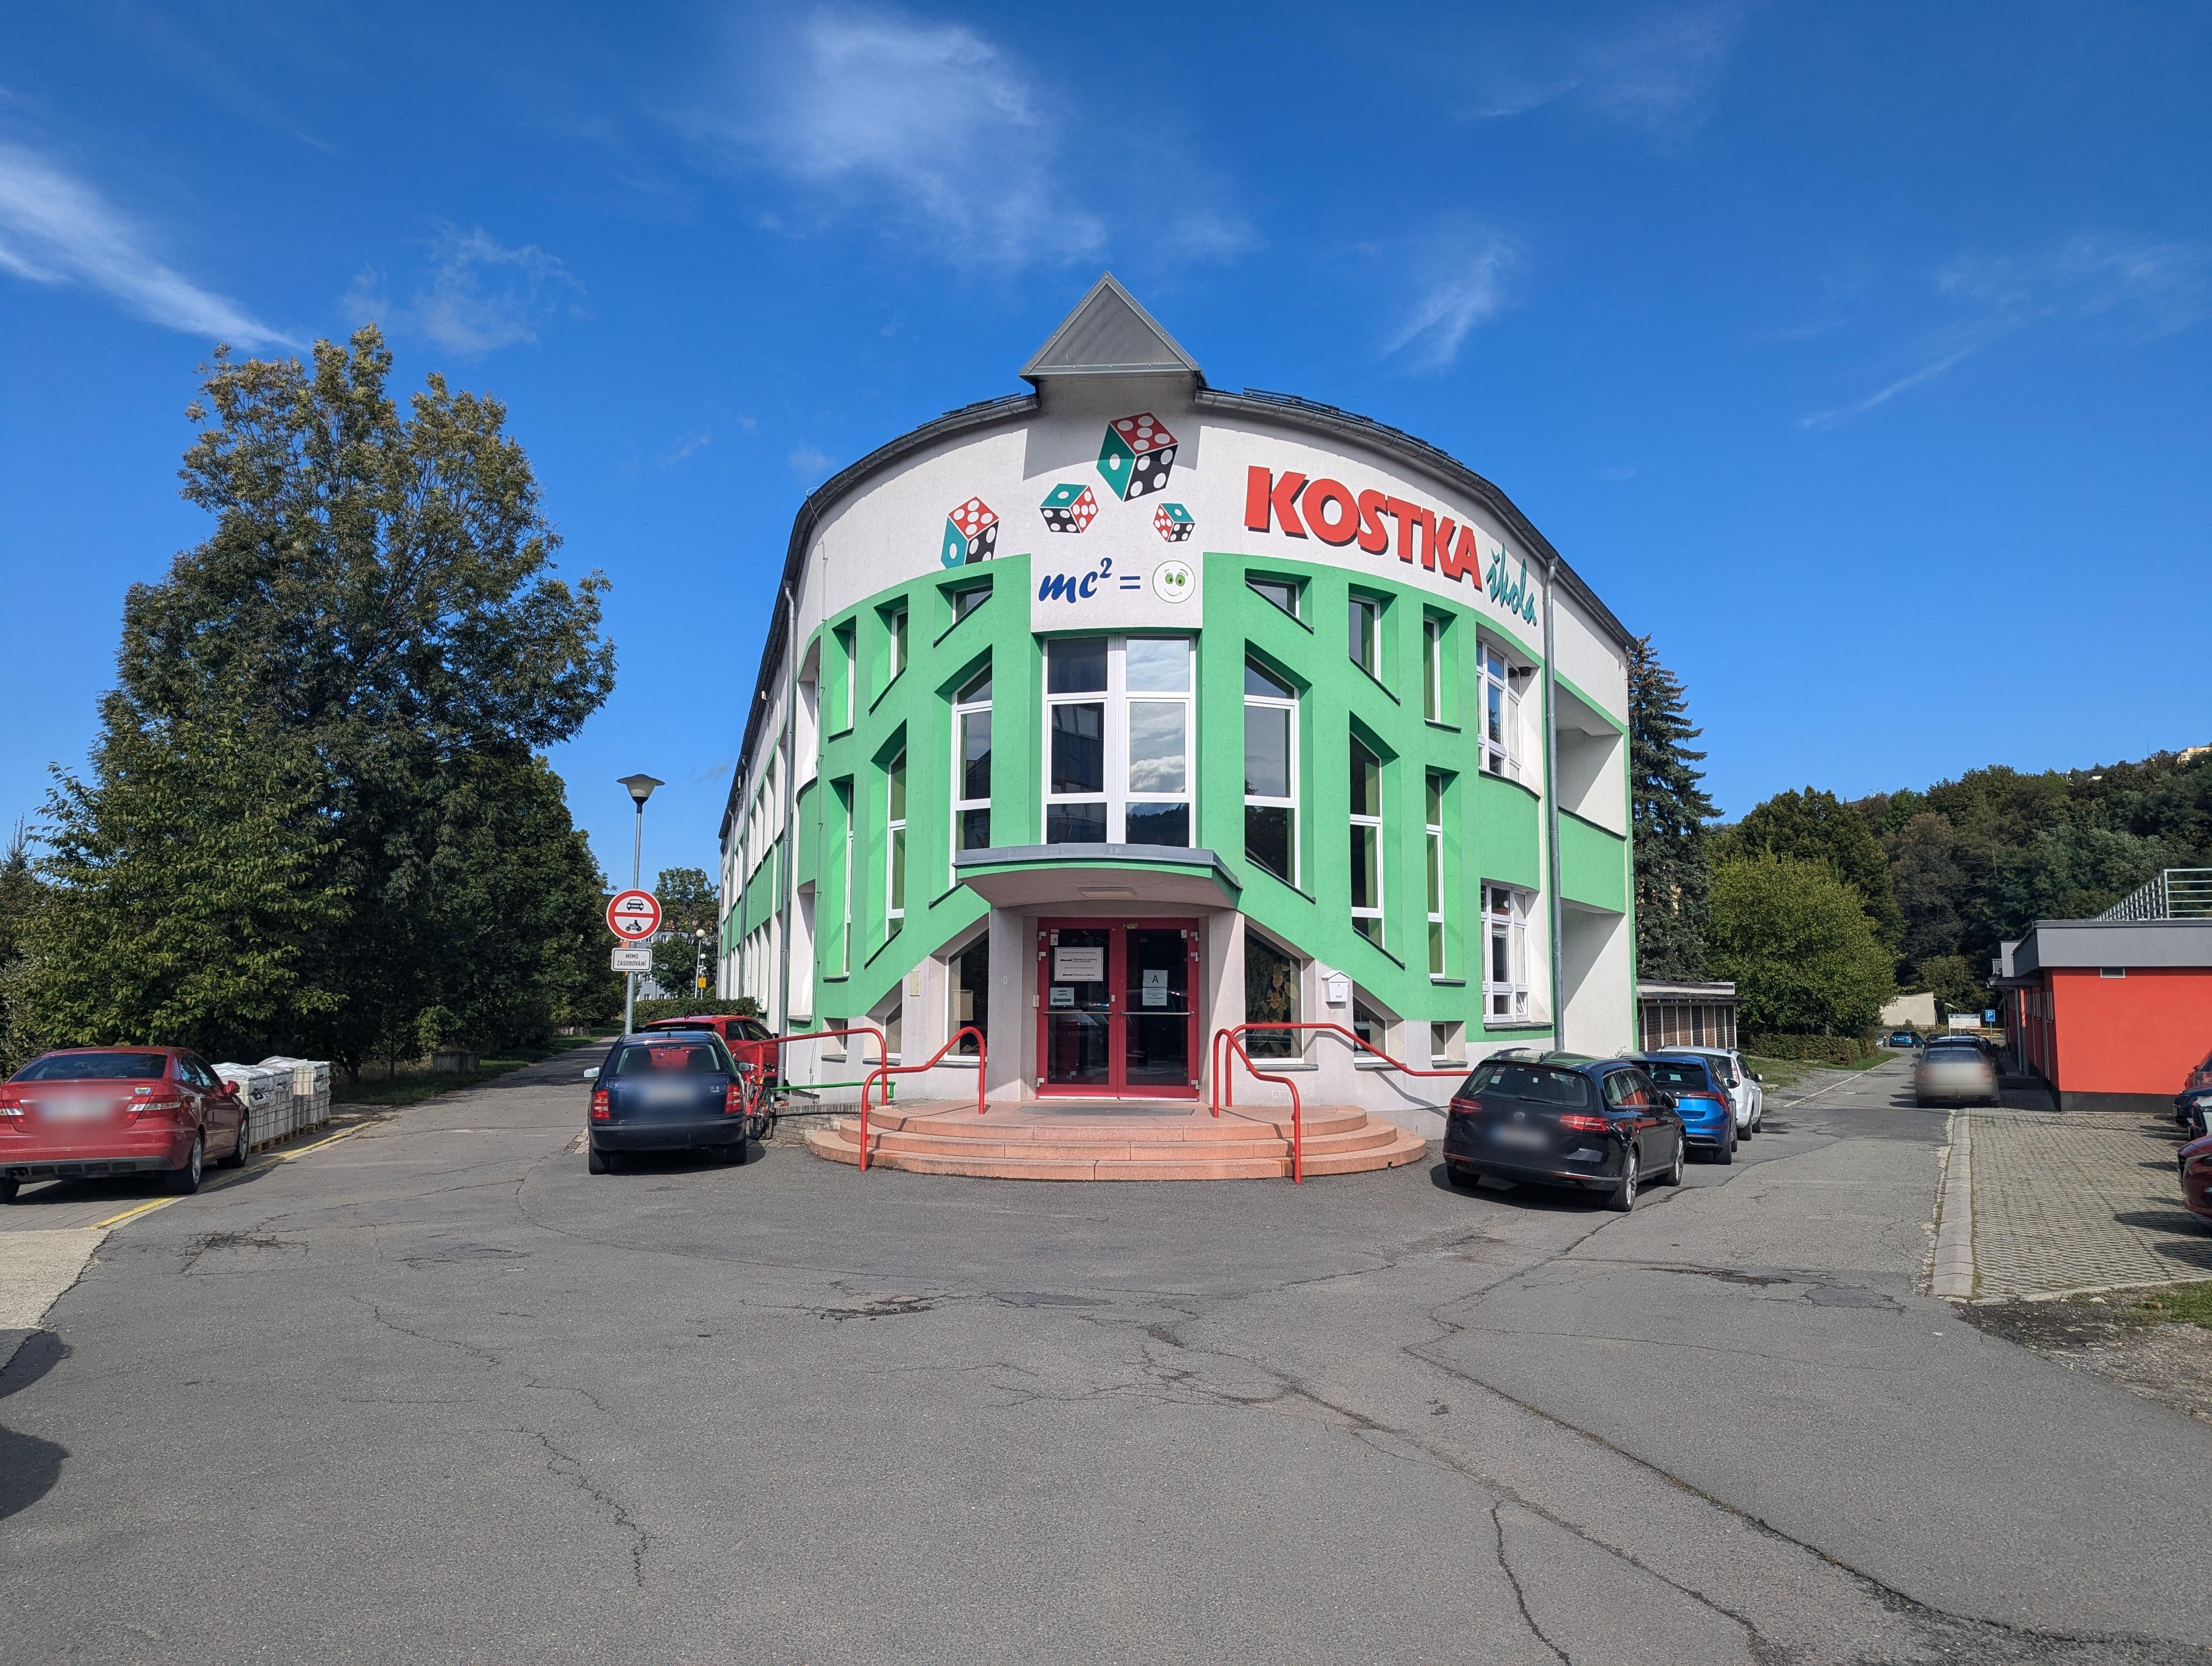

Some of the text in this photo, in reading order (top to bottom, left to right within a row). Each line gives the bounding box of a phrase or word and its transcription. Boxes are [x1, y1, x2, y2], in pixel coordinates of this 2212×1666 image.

[1244, 465, 1482, 593] KOSTKA
[1486, 542, 1537, 627] škola
[1152, 975, 1159, 983] A
